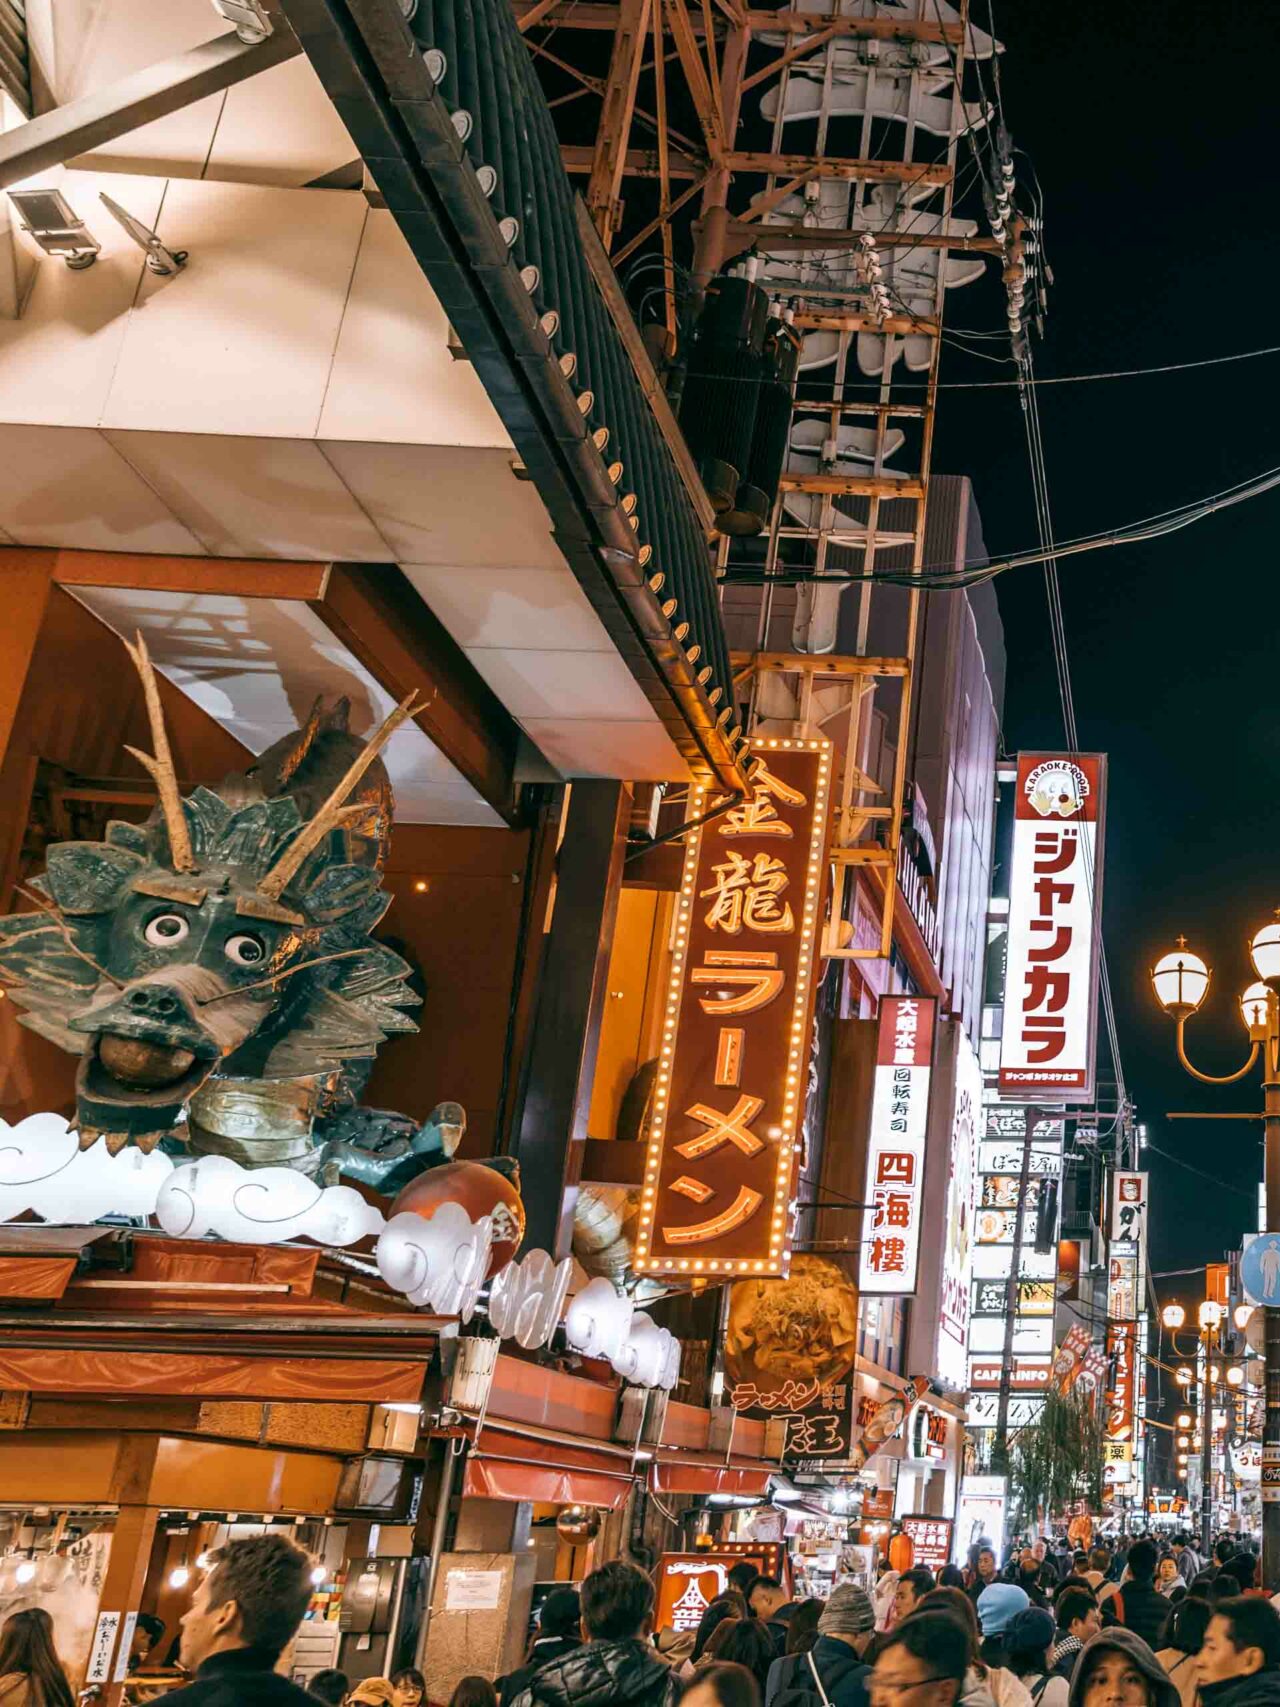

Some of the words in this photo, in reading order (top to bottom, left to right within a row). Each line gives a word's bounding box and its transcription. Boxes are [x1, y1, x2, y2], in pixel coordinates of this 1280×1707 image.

[662, 756, 806, 1245] 金龍ラーメン
[1021, 830, 1077, 1063] ジャンカラ
[890, 1067, 912, 1133] 回転寿司
[731, 1377, 820, 1412] ラーメン
